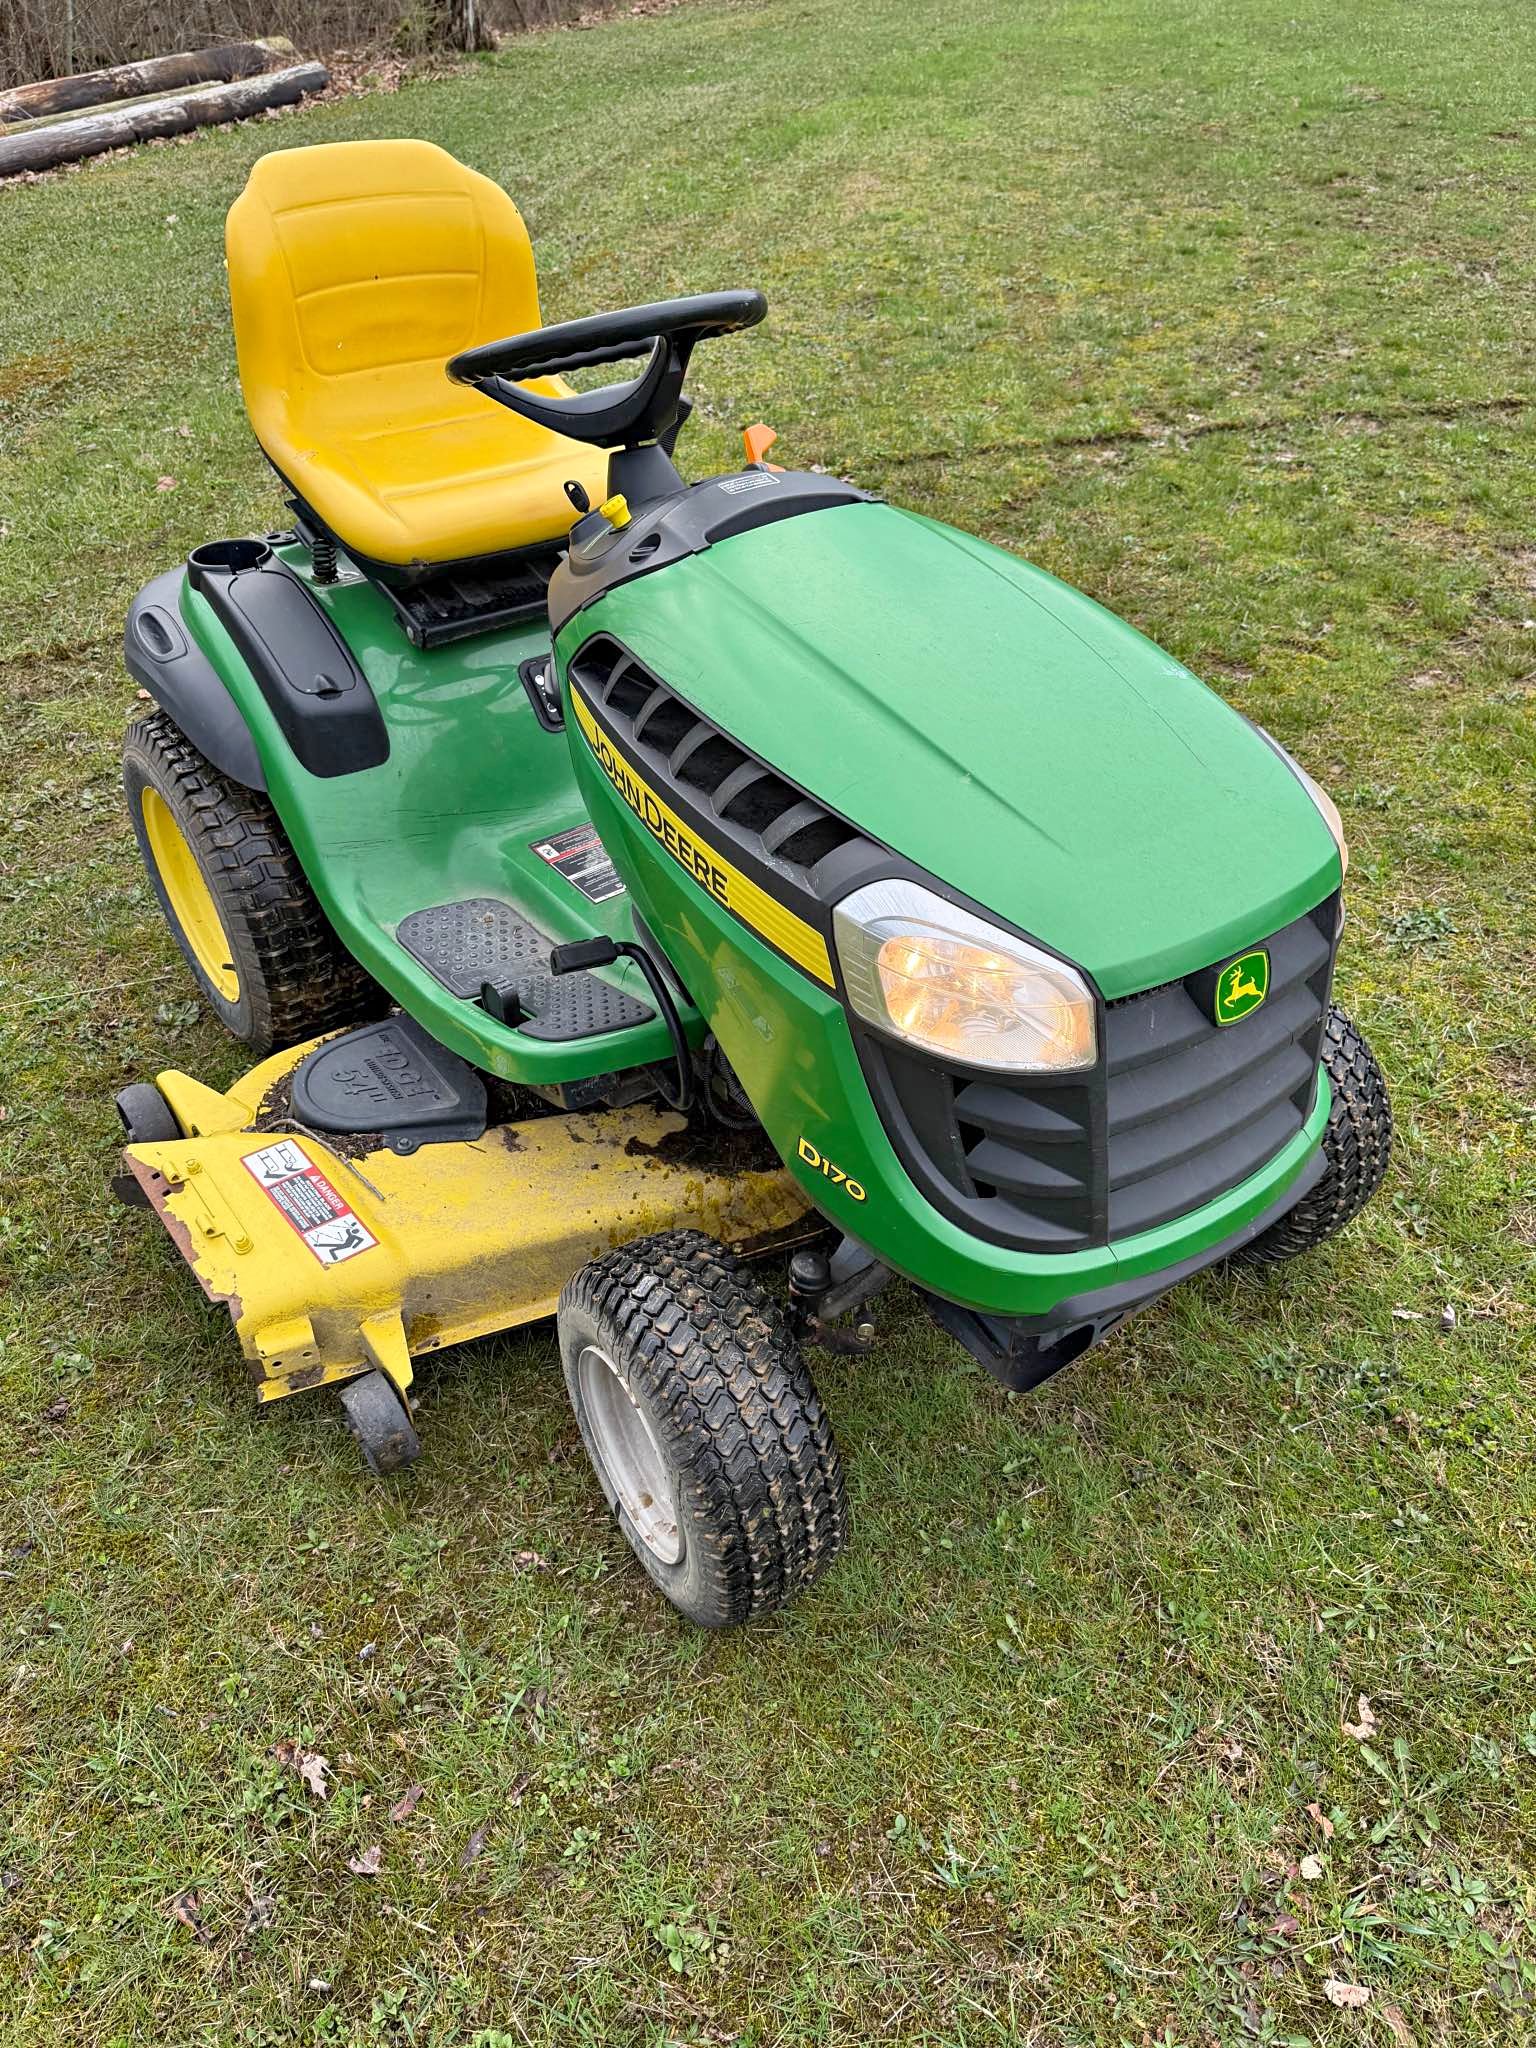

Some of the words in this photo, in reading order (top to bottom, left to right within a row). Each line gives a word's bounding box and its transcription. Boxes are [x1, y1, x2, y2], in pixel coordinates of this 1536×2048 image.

[592, 726, 642, 814] JOHN
[644, 793, 730, 904] DEERE
[317, 1180, 344, 1210] DANGER
[797, 1135, 867, 1202] D170
